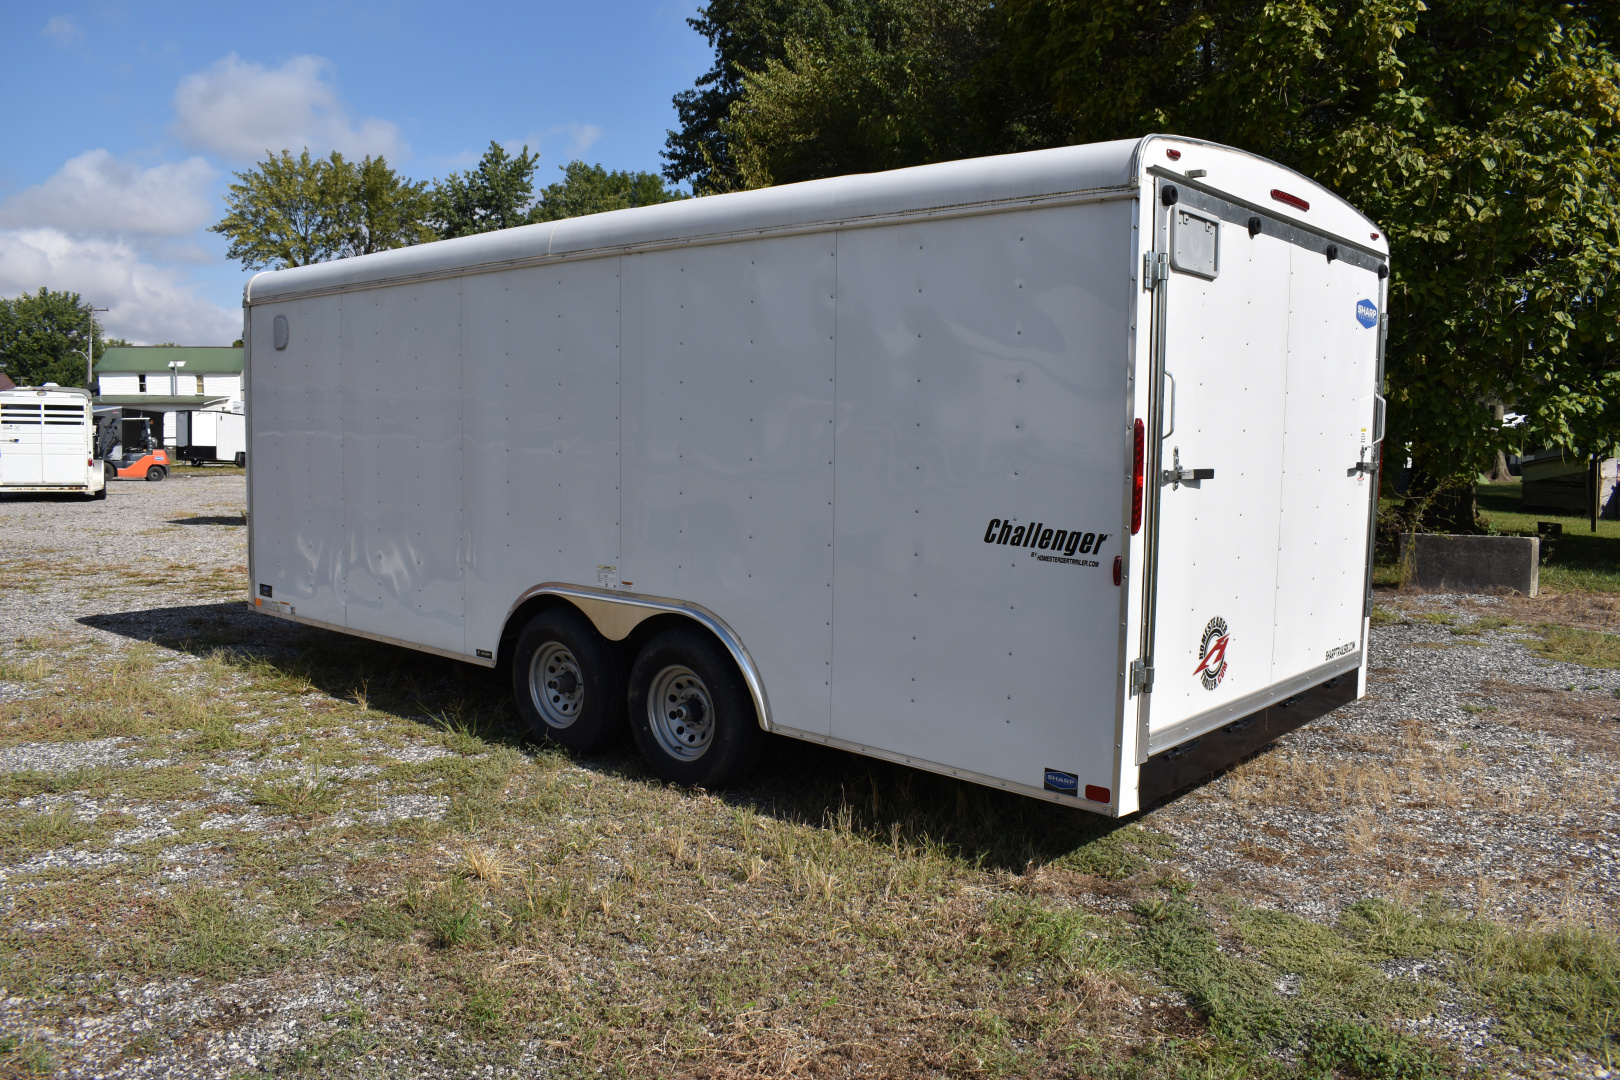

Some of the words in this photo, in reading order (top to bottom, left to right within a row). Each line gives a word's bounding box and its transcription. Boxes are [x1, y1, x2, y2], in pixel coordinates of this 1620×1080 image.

[1357, 304, 1377, 319] SHARP
[983, 518, 1108, 556] Challenger
[1047, 774, 1075, 785] SHARP
